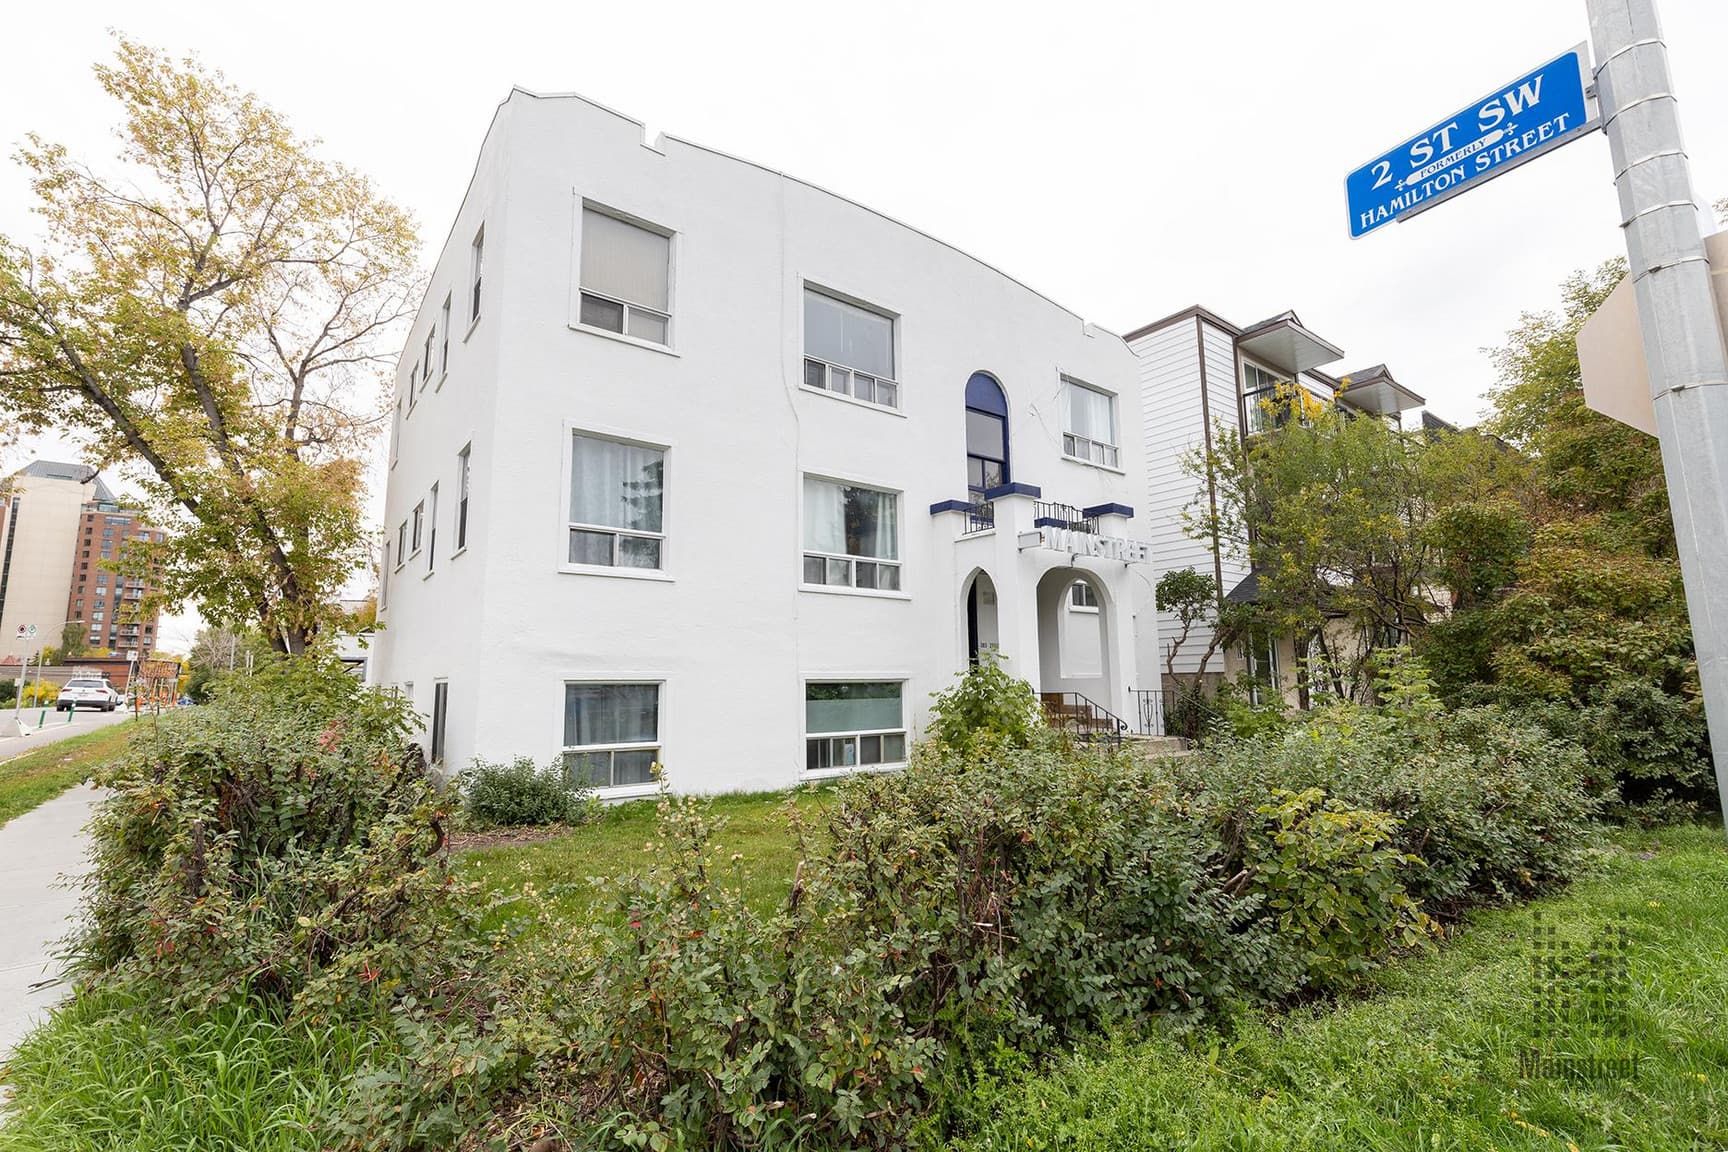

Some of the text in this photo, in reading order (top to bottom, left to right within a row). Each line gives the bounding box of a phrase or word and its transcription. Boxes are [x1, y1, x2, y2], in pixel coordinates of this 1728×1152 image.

[1360, 112, 1570, 229] HAMILTON STREET
[1370, 74, 1544, 190] 2 ST SW
[1420, 138, 1488, 178] FORMERLY
